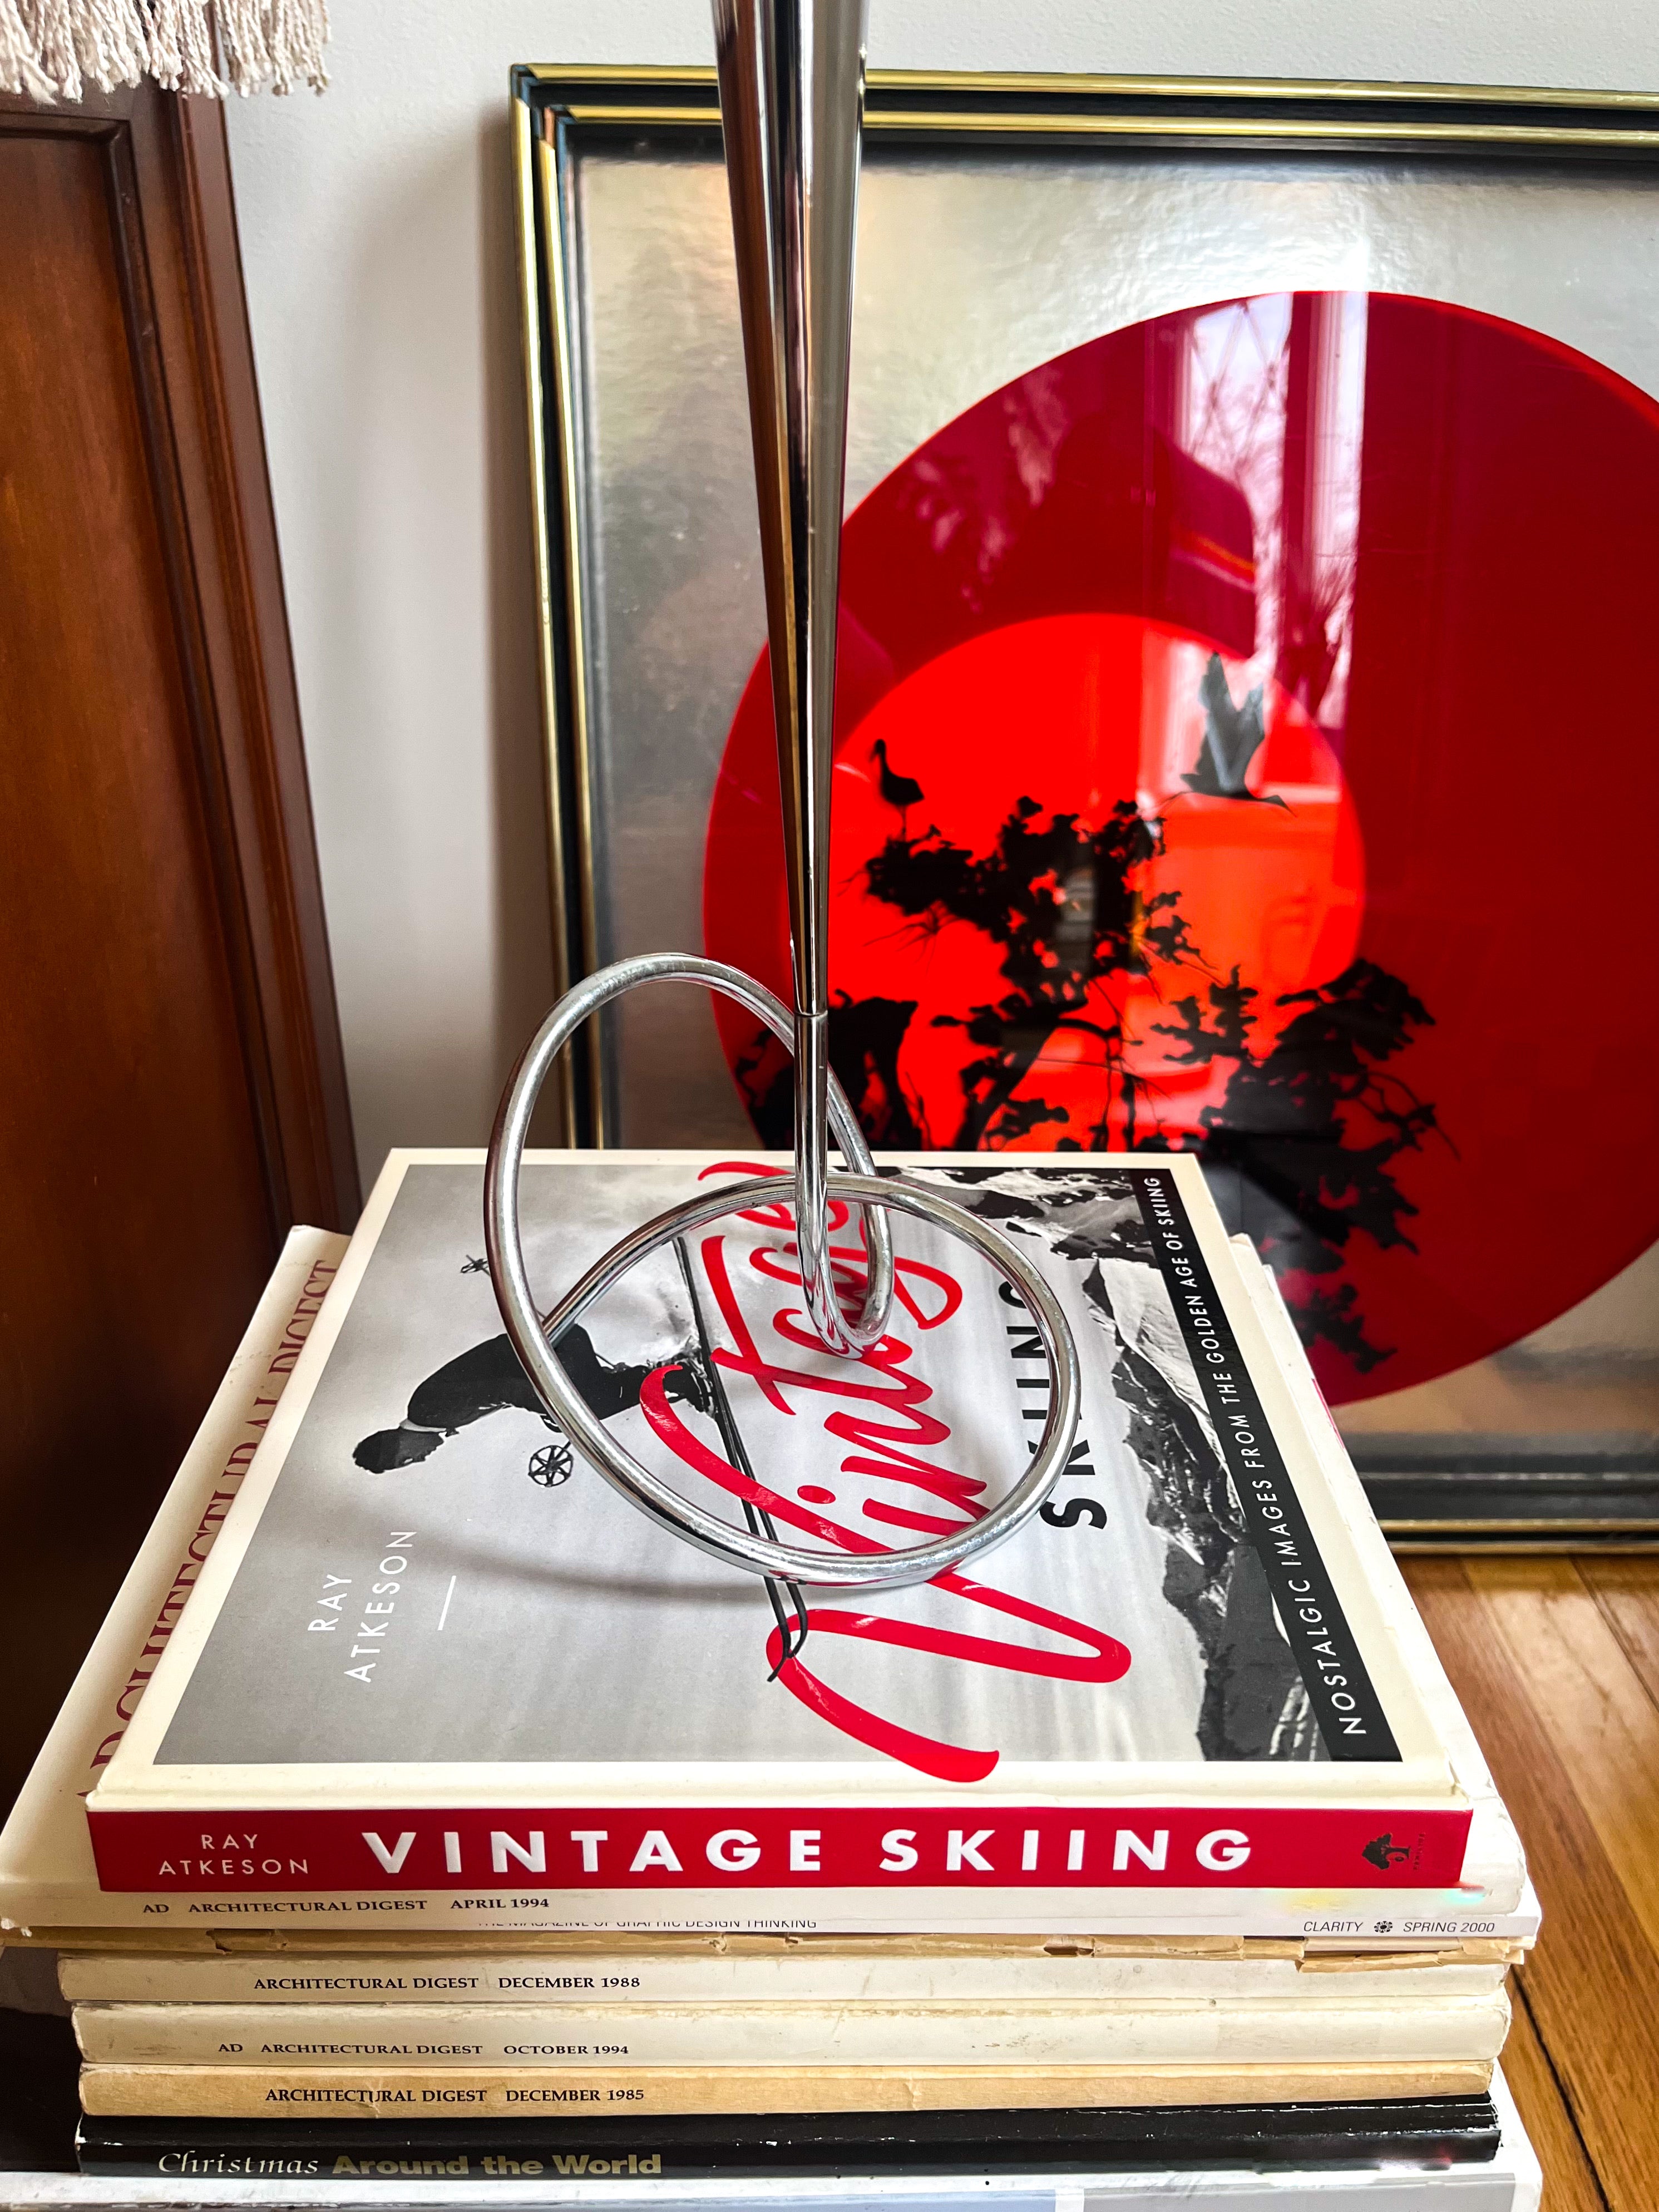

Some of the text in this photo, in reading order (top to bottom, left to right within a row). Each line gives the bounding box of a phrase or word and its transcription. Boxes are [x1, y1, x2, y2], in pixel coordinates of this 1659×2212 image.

[1143, 1177, 1367, 1735] NOSTALGIC IMAGES FROM THE GOLDEN AGE OF SKIING
[308, 1574, 352, 1631] RAY
[344, 1531, 416, 1683] ATKESON
[201, 1834, 258, 1850] RAY
[361, 1829, 1252, 1874] VINTAGE SKIING
[159, 1859, 308, 1875] ATKESON
[143, 1898, 550, 1913] AD ARCHITECTURAL DIGEST APRIL 1994
[748, 1920, 816, 1928] THINKING
[1304, 1921, 1495, 1933] CLARITY SPRING 2000
[254, 1977, 640, 1989] ARCHITECTURAL DIGEST DECEMBER 1988
[218, 2043, 629, 2055] AD ARCHITECTURAL DIGEST OCTOBER 1994
[265, 2088, 645, 2103] ARCHITECTURAL DIGEST DECEMBER 1985
[158, 2150, 661, 2175] Christmas Around the World
